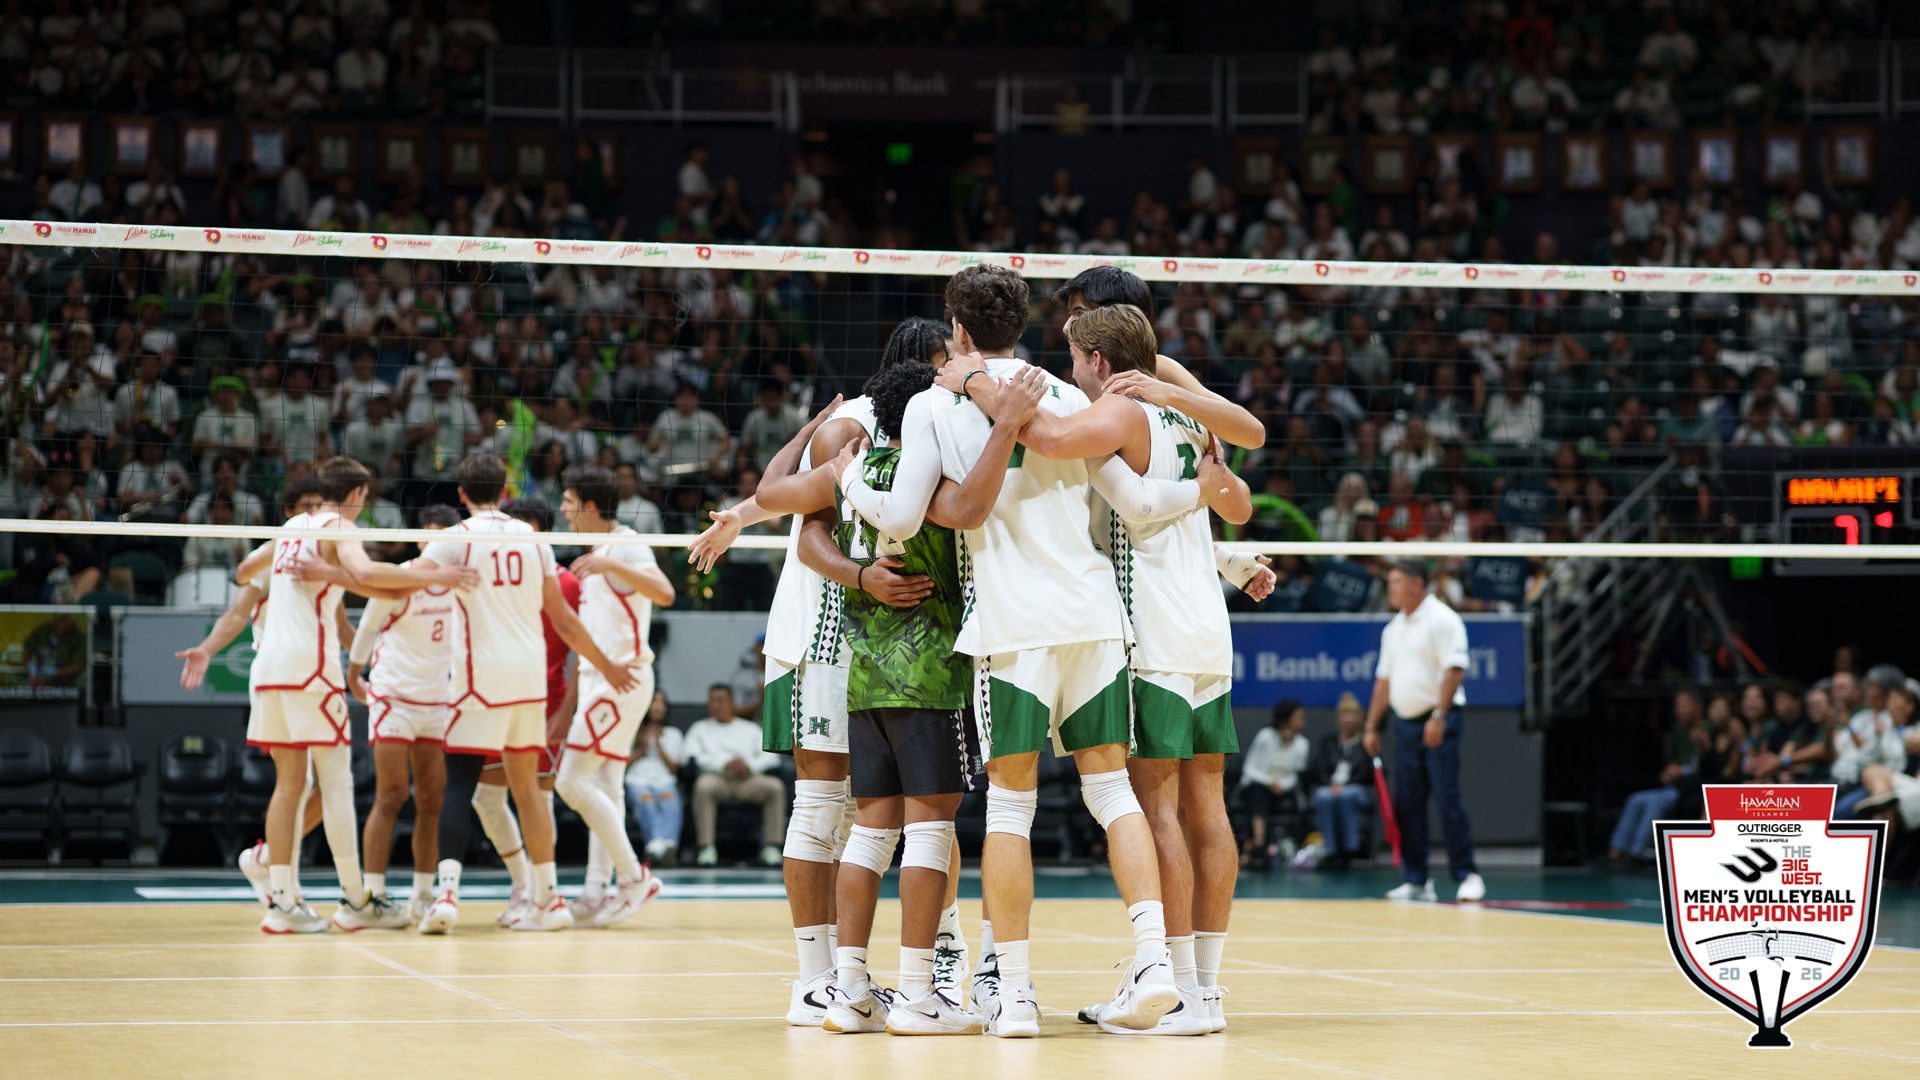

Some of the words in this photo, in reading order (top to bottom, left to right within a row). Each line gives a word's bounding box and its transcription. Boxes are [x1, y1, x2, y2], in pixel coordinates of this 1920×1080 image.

[72, 226, 97, 235] HAWAII
[150, 228, 175, 240] Bakery
[241, 233, 266, 241] HAWAII
[317, 235, 342, 247] Bakery
[491, 550, 523, 586] 10
[432, 619, 444, 642] 2
[1255, 651, 1338, 682] Bank
[1340, 651, 1379, 682] of
